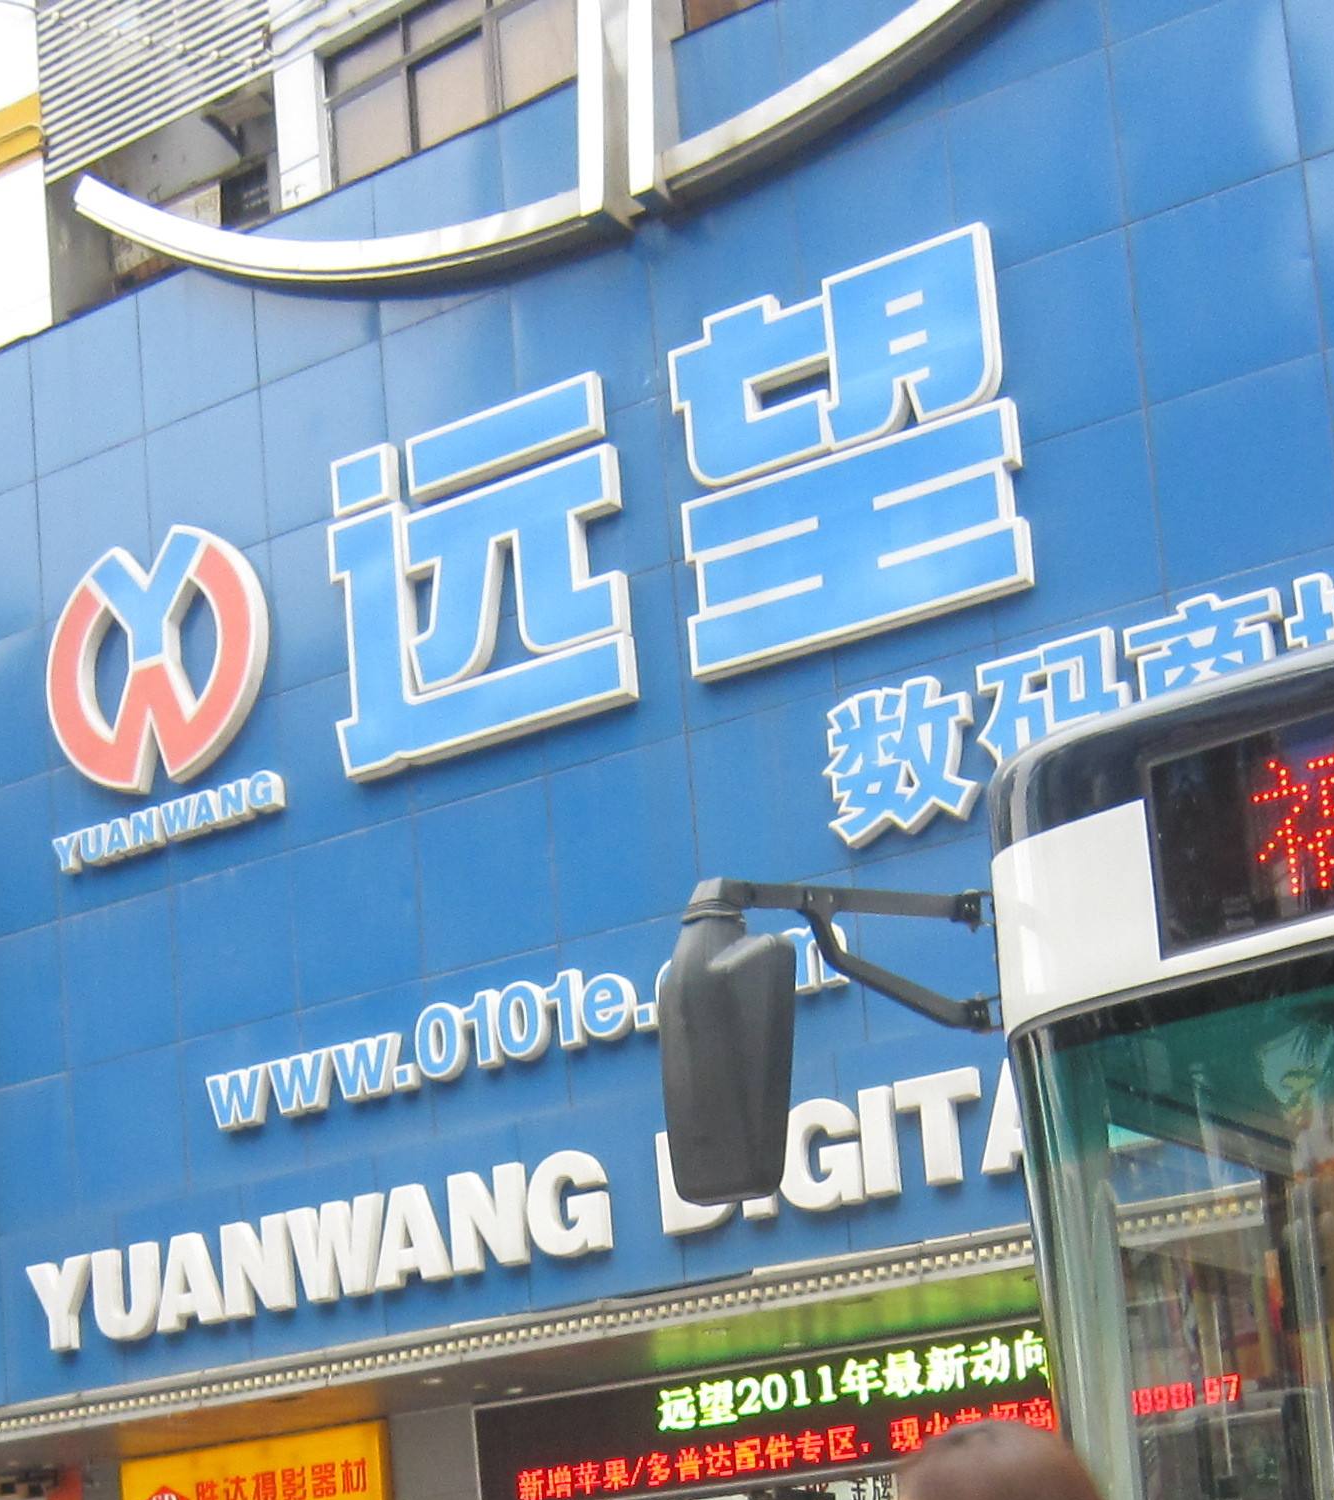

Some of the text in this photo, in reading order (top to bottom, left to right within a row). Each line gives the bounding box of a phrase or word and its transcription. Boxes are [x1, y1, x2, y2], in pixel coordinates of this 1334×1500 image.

[328, 221, 1036, 781] 远望
[52, 769, 286, 876] YUANWANG
[25, 1149, 614, 1353] YUANWANG
[657, 1328, 1051, 1433] 远望2011年最新动向
